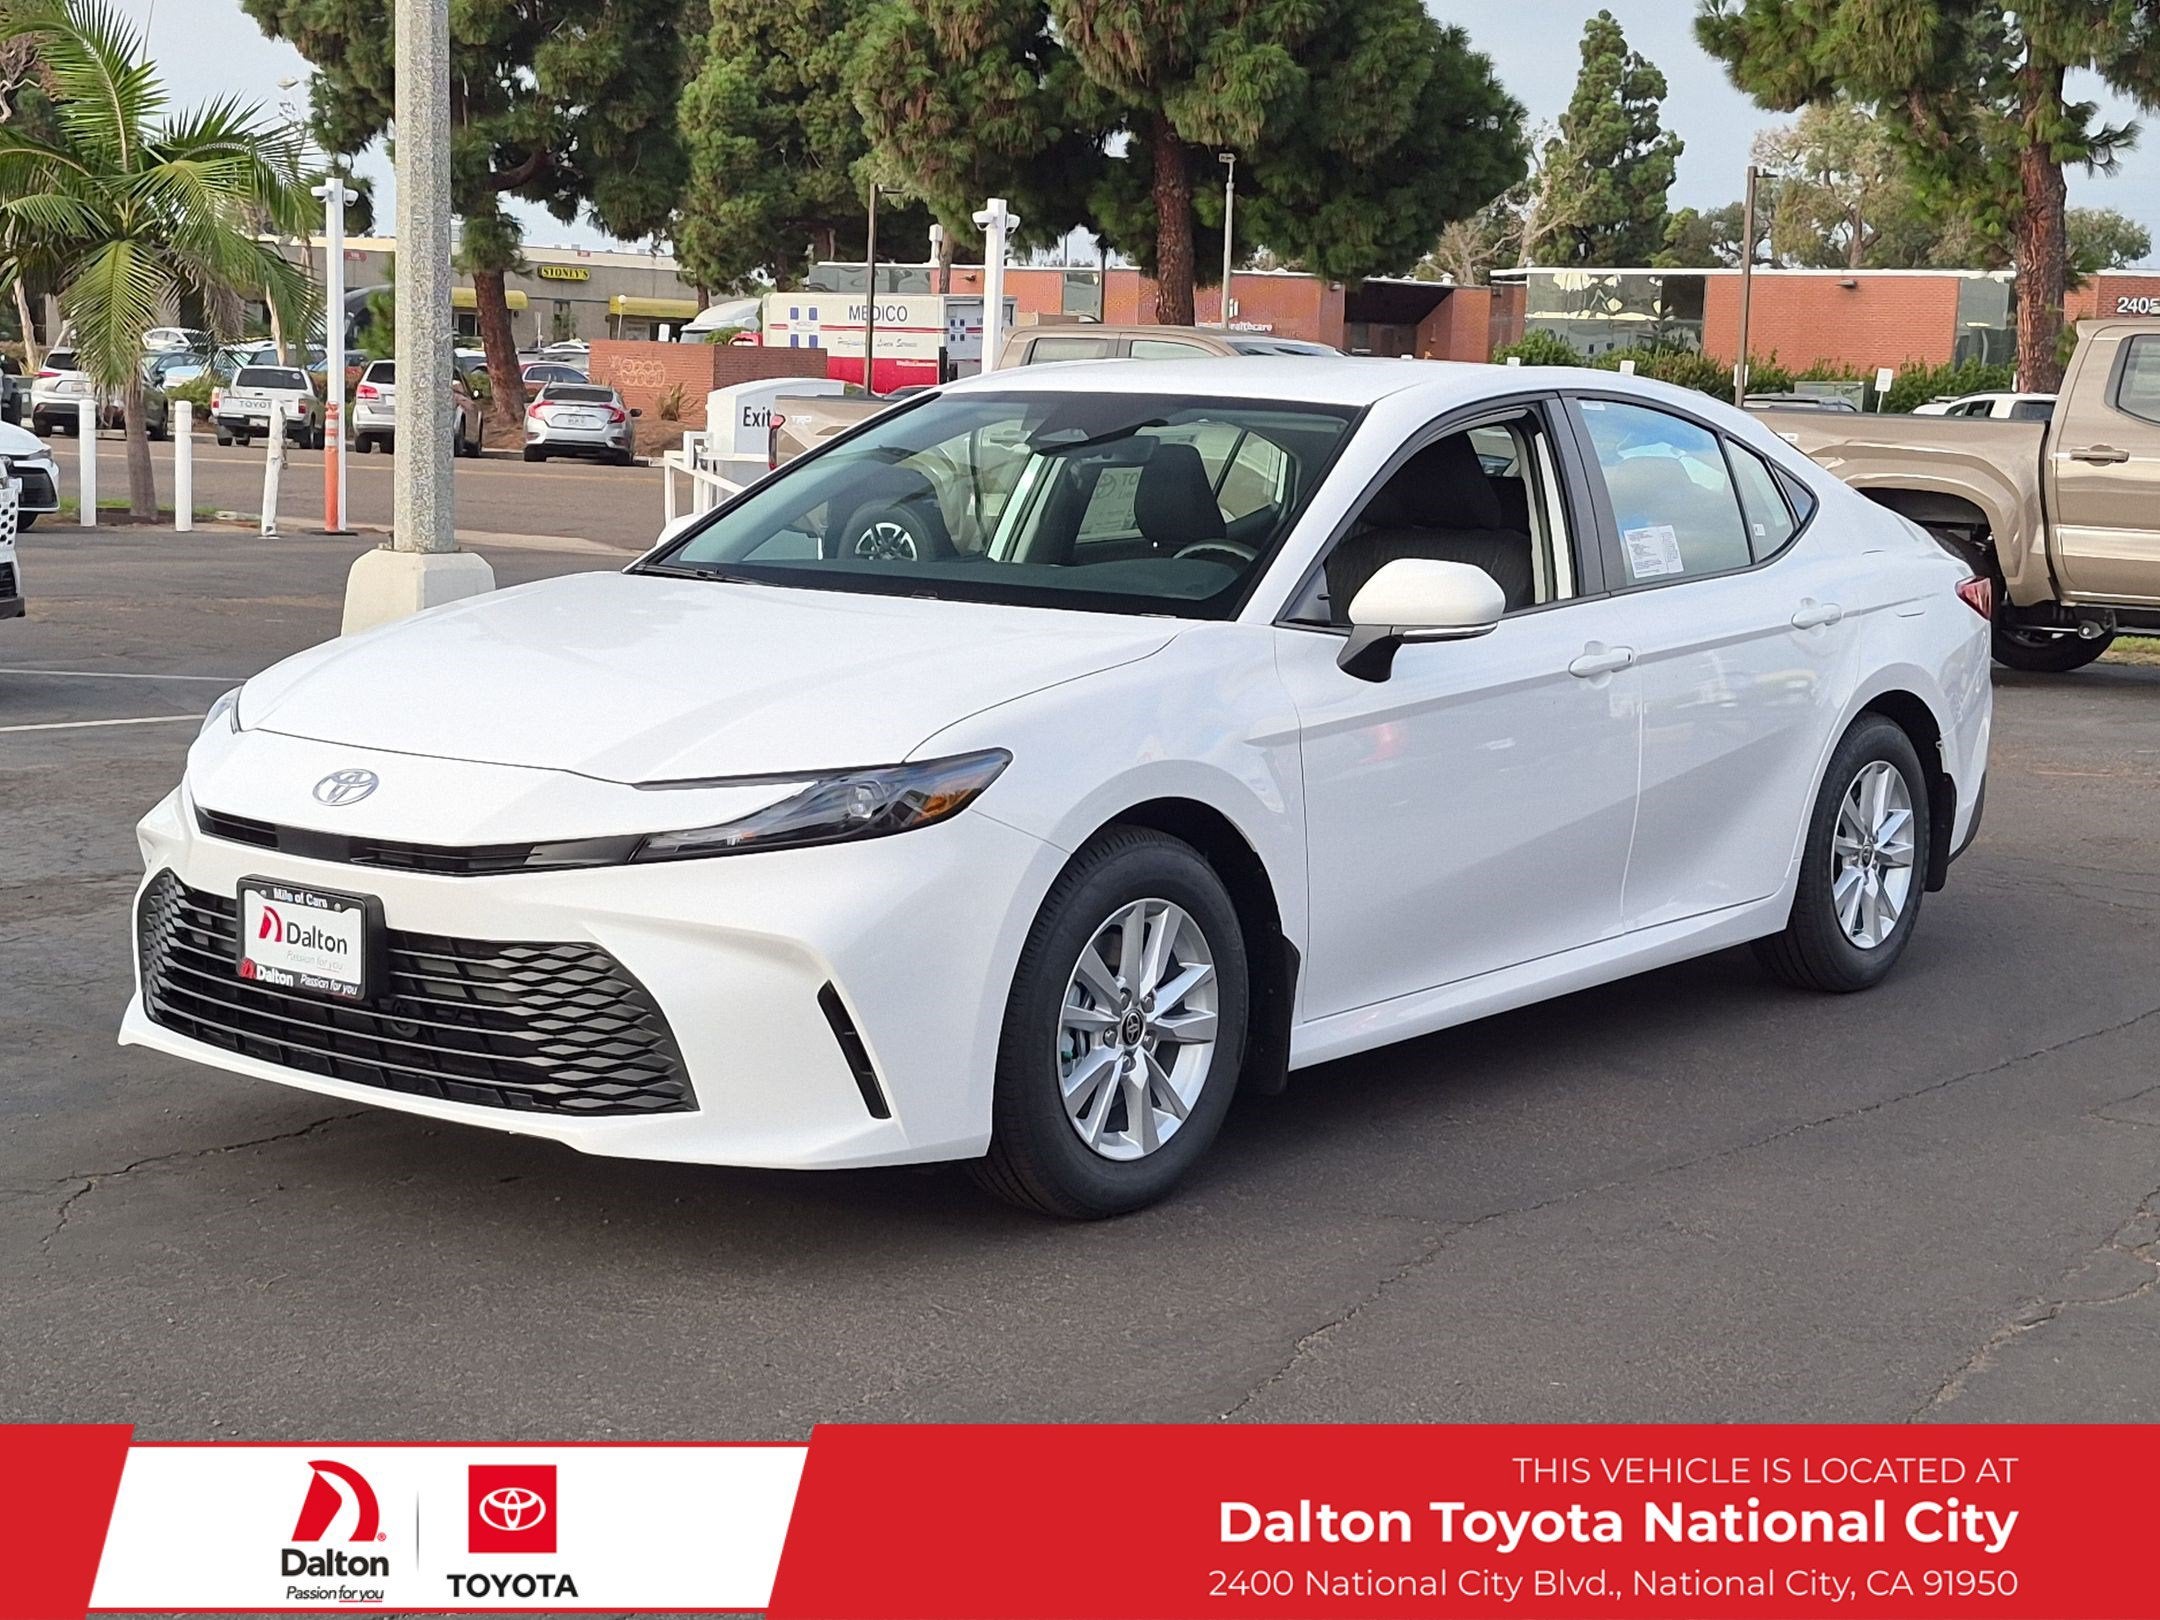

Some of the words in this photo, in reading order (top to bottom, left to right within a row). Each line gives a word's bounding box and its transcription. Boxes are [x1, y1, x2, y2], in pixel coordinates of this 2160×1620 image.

[848, 305, 908, 322] MEDICO
[239, 400, 272, 409] TOYOT
[742, 406, 772, 427] Exit
[273, 887, 294, 902] Mile
[294, 892, 305, 904] of
[305, 893, 328, 908] Cars
[286, 921, 348, 955] Dalton
[256, 964, 294, 987] Dalton
[300, 973, 329, 990] Passion
[330, 979, 341, 991] for
[341, 985, 358, 996] you
